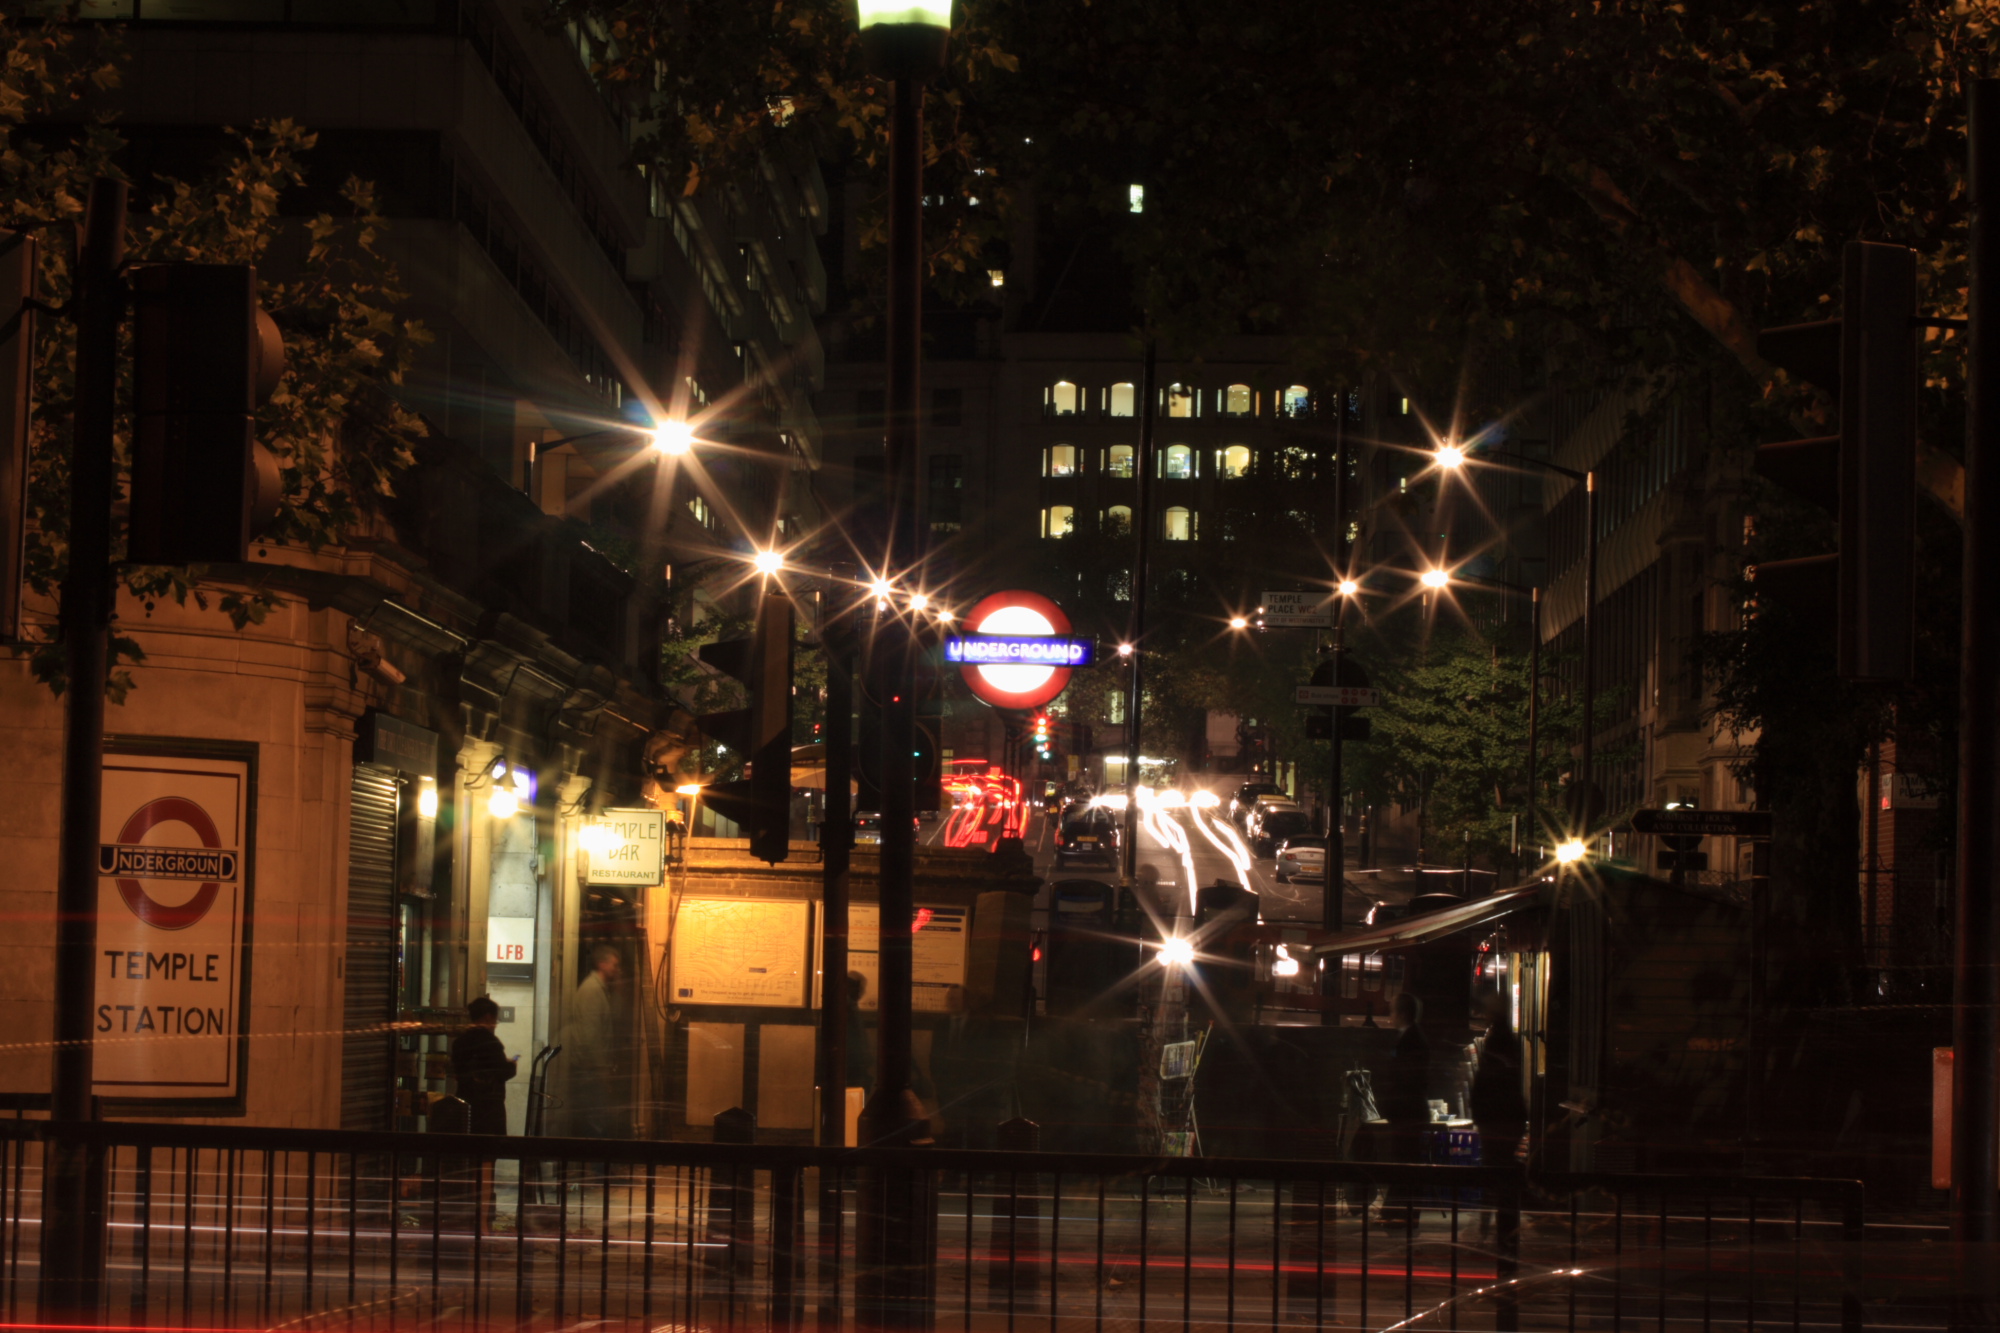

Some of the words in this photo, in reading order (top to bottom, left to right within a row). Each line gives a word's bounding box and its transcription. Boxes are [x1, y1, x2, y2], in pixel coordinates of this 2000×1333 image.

[1269, 594, 1302, 604] TEMPLE
[1268, 605, 1294, 614] PLACE
[1298, 605, 1318, 614] WC2
[950, 641, 1083, 660] UNDERGROUND
[1705, 813, 1733, 823] HOUSE
[597, 822, 658, 840] EMPLE
[1652, 823, 1674, 831] AND
[1677, 823, 1737, 832] COLLECTIONS
[99, 846, 236, 880] UNDERGROUND
[592, 869, 656, 879] RESTAURANT
[496, 944, 524, 960] LFB
[104, 950, 219, 982] TEMPLE
[97, 1004, 224, 1035] STATION
